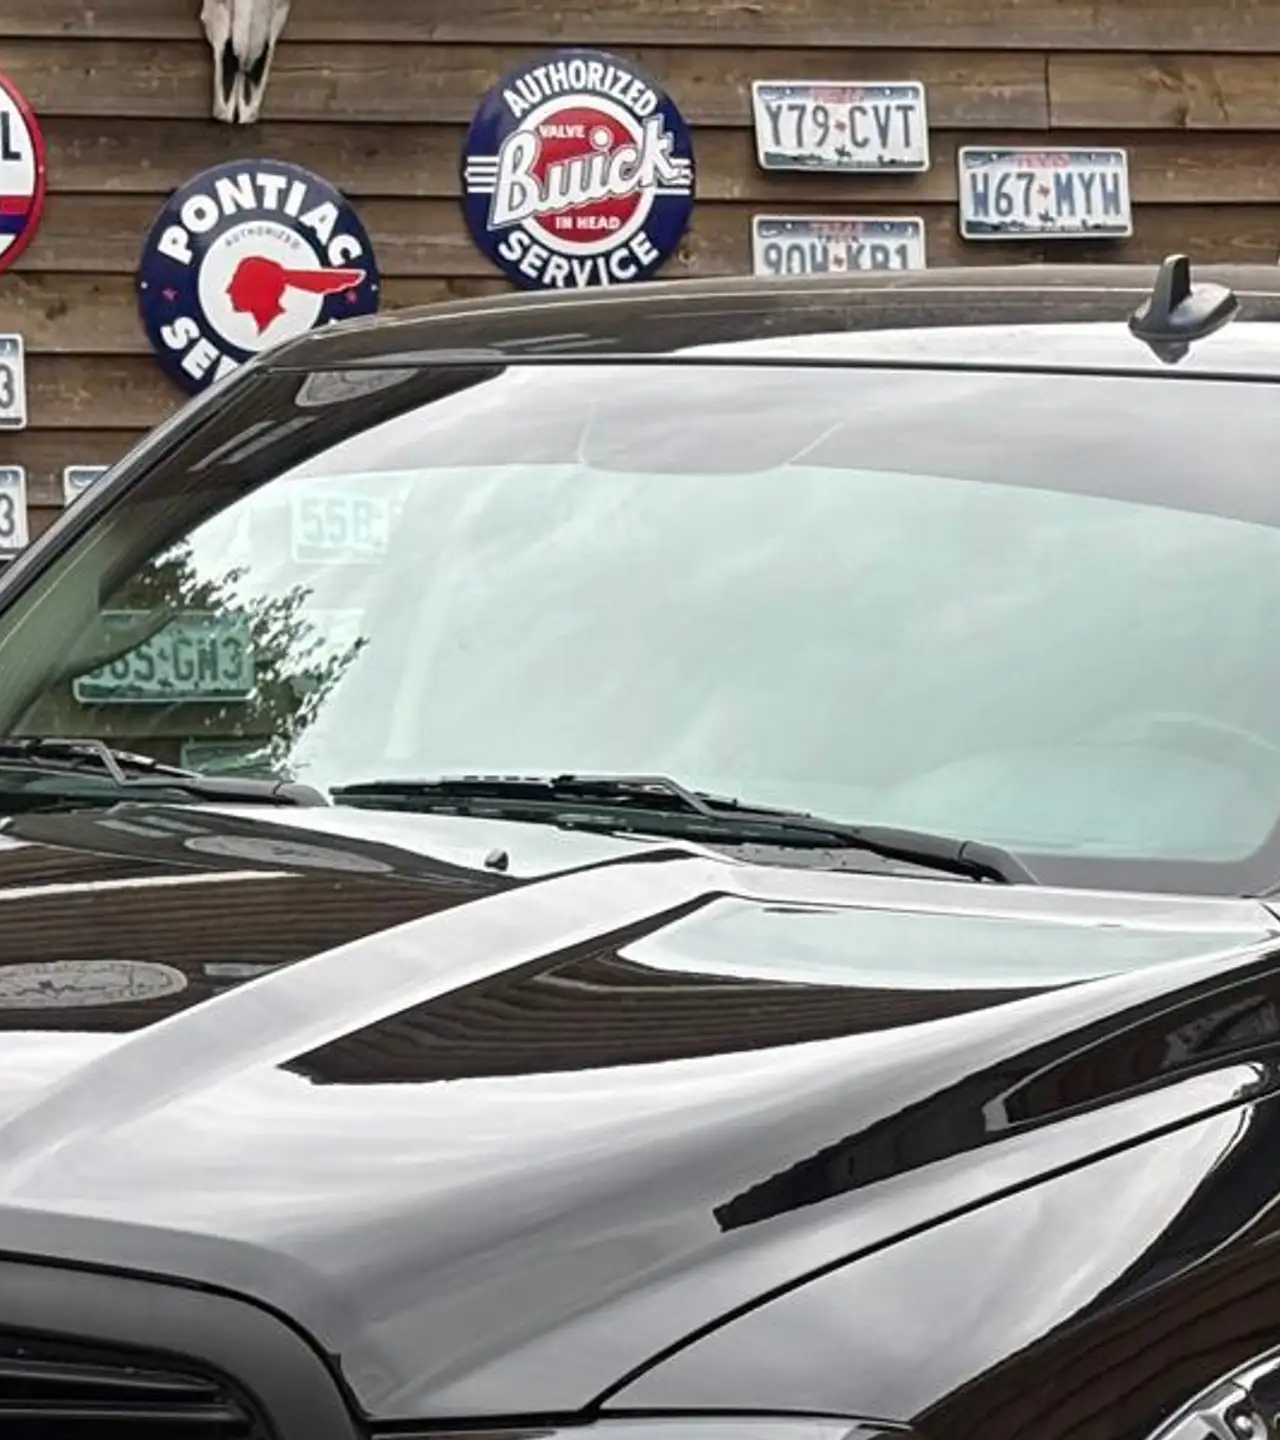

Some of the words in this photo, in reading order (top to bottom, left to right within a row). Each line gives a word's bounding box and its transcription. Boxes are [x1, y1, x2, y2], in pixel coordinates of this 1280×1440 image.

[503, 59, 658, 119] AUTHORIZED
[539, 124, 586, 139] VALVE
[765, 104, 830, 148] Y79
[848, 104, 915, 149] CVT
[487, 113, 678, 231] Buick
[157, 172, 363, 268] PONTIAC
[577, 216, 621, 230] HEAD
[498, 230, 660, 288] SERVICE
